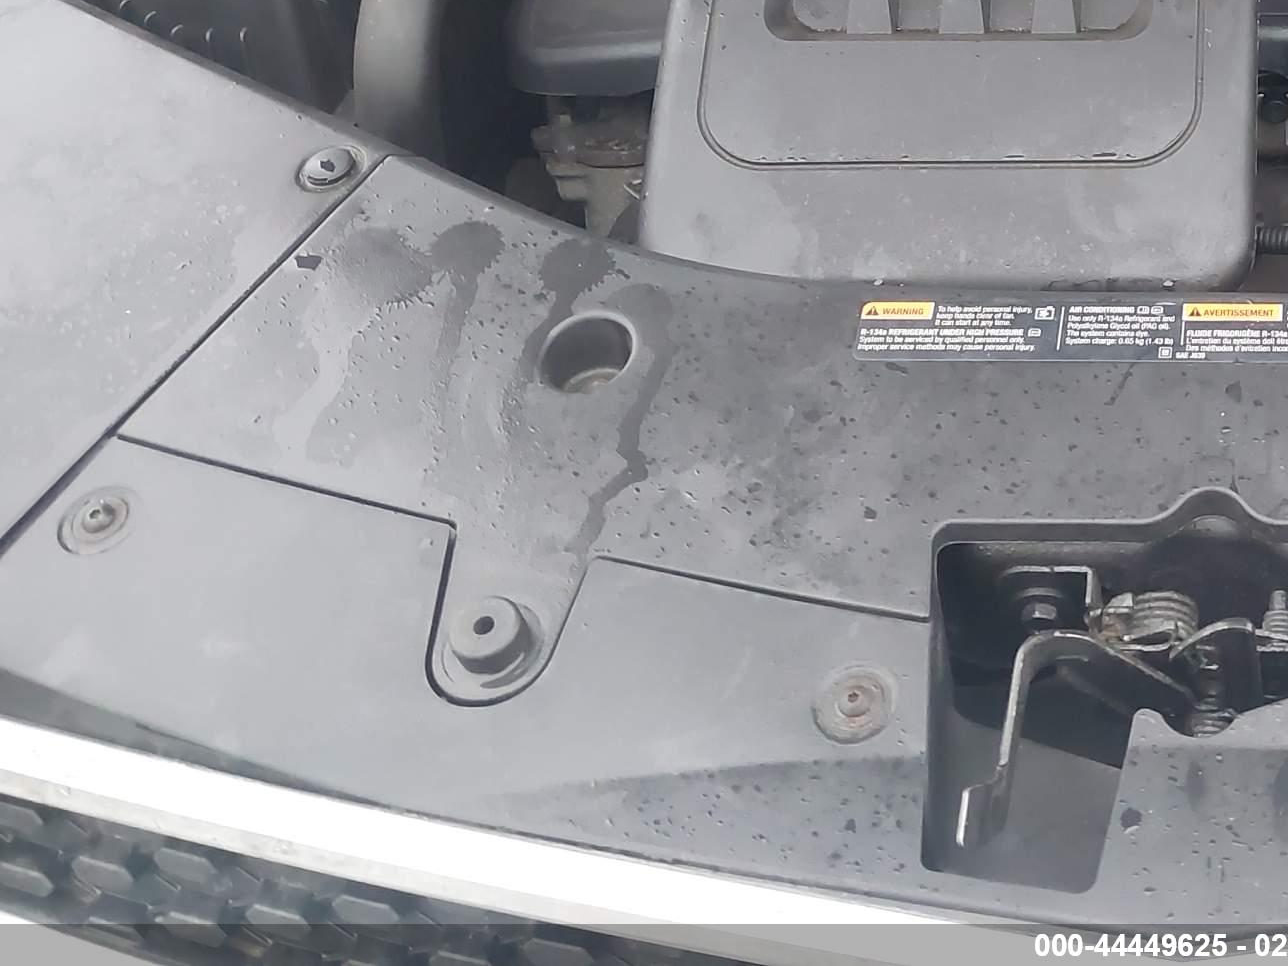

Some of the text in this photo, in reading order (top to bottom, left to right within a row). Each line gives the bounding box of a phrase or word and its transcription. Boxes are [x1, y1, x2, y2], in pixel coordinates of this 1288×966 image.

[882, 307, 924, 315] WARNING
[947, 306, 962, 314] help
[982, 306, 1012, 314] personal
[1069, 306, 1134, 314] AIR CONDITIONING
[1082, 315, 1097, 324] only
[1124, 315, 1161, 323] Refrigerant
[1110, 322, 1130, 330] Glycol
[860, 328, 1024, 336] R-134a REFRIGERANT UNDER HIGH PRESSURE
[1136, 330, 1150, 338] dye.
[859, 336, 885, 344] System
[944, 336, 974, 344] qualified
[1065, 338, 1091, 346] System
[1092, 338, 1117, 346] charge:
[857, 344, 888, 352] Improper
[984, 344, 1014, 352] personal
